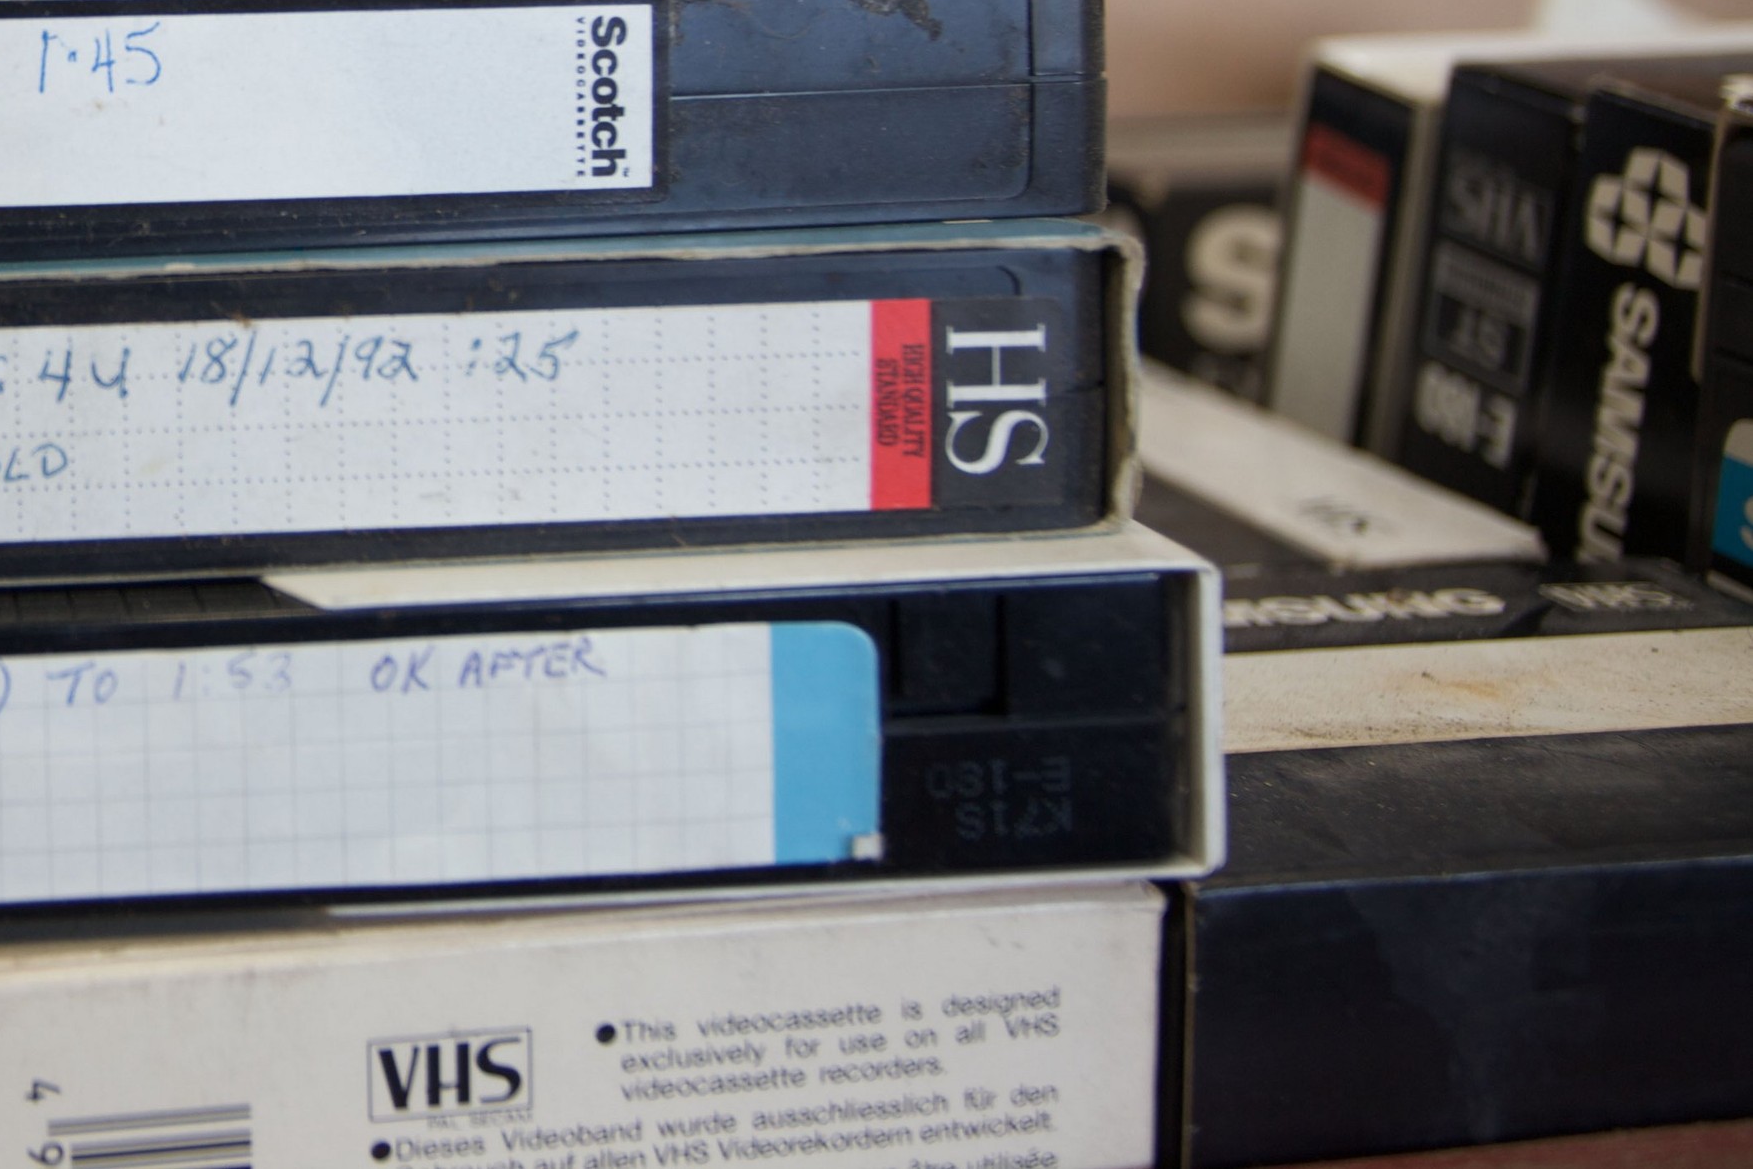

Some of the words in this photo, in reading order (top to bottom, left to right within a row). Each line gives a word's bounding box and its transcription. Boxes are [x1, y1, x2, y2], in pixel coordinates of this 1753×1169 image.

[574, 15, 587, 179] VIDEOCASSETTE
[590, 14, 628, 179] Scotch
[876, 357, 900, 448] STANDARD
[946, 323, 1050, 475] HS
[1578, 281, 1660, 567] SAMSU
[47, 662, 119, 706] TO
[370, 646, 433, 692] OK
[458, 636, 609, 689] AFTER
[619, 1036, 766, 1074] exclusively
[784, 1034, 820, 1058] for
[838, 1032, 888, 1055] use
[903, 1026, 939, 1050] on
[954, 1019, 988, 1046] all
[1002, 1011, 1062, 1040] VHS
[622, 1017, 677, 1043] This
[696, 1001, 883, 1037] videocassette
[900, 996, 924, 1021] is
[941, 985, 1062, 1020] designed
[378, 1036, 523, 1110] VHS
[619, 1064, 807, 1103] videocassette
[395, 1135, 487, 1163] Dieses
[501, 1117, 644, 1152] Videoband
[656, 1109, 737, 1139] wurde
[751, 1091, 950, 1132] ausschliesslich
[1008, 1083, 1061, 1108] den
[651, 1140, 712, 1168] VHS
